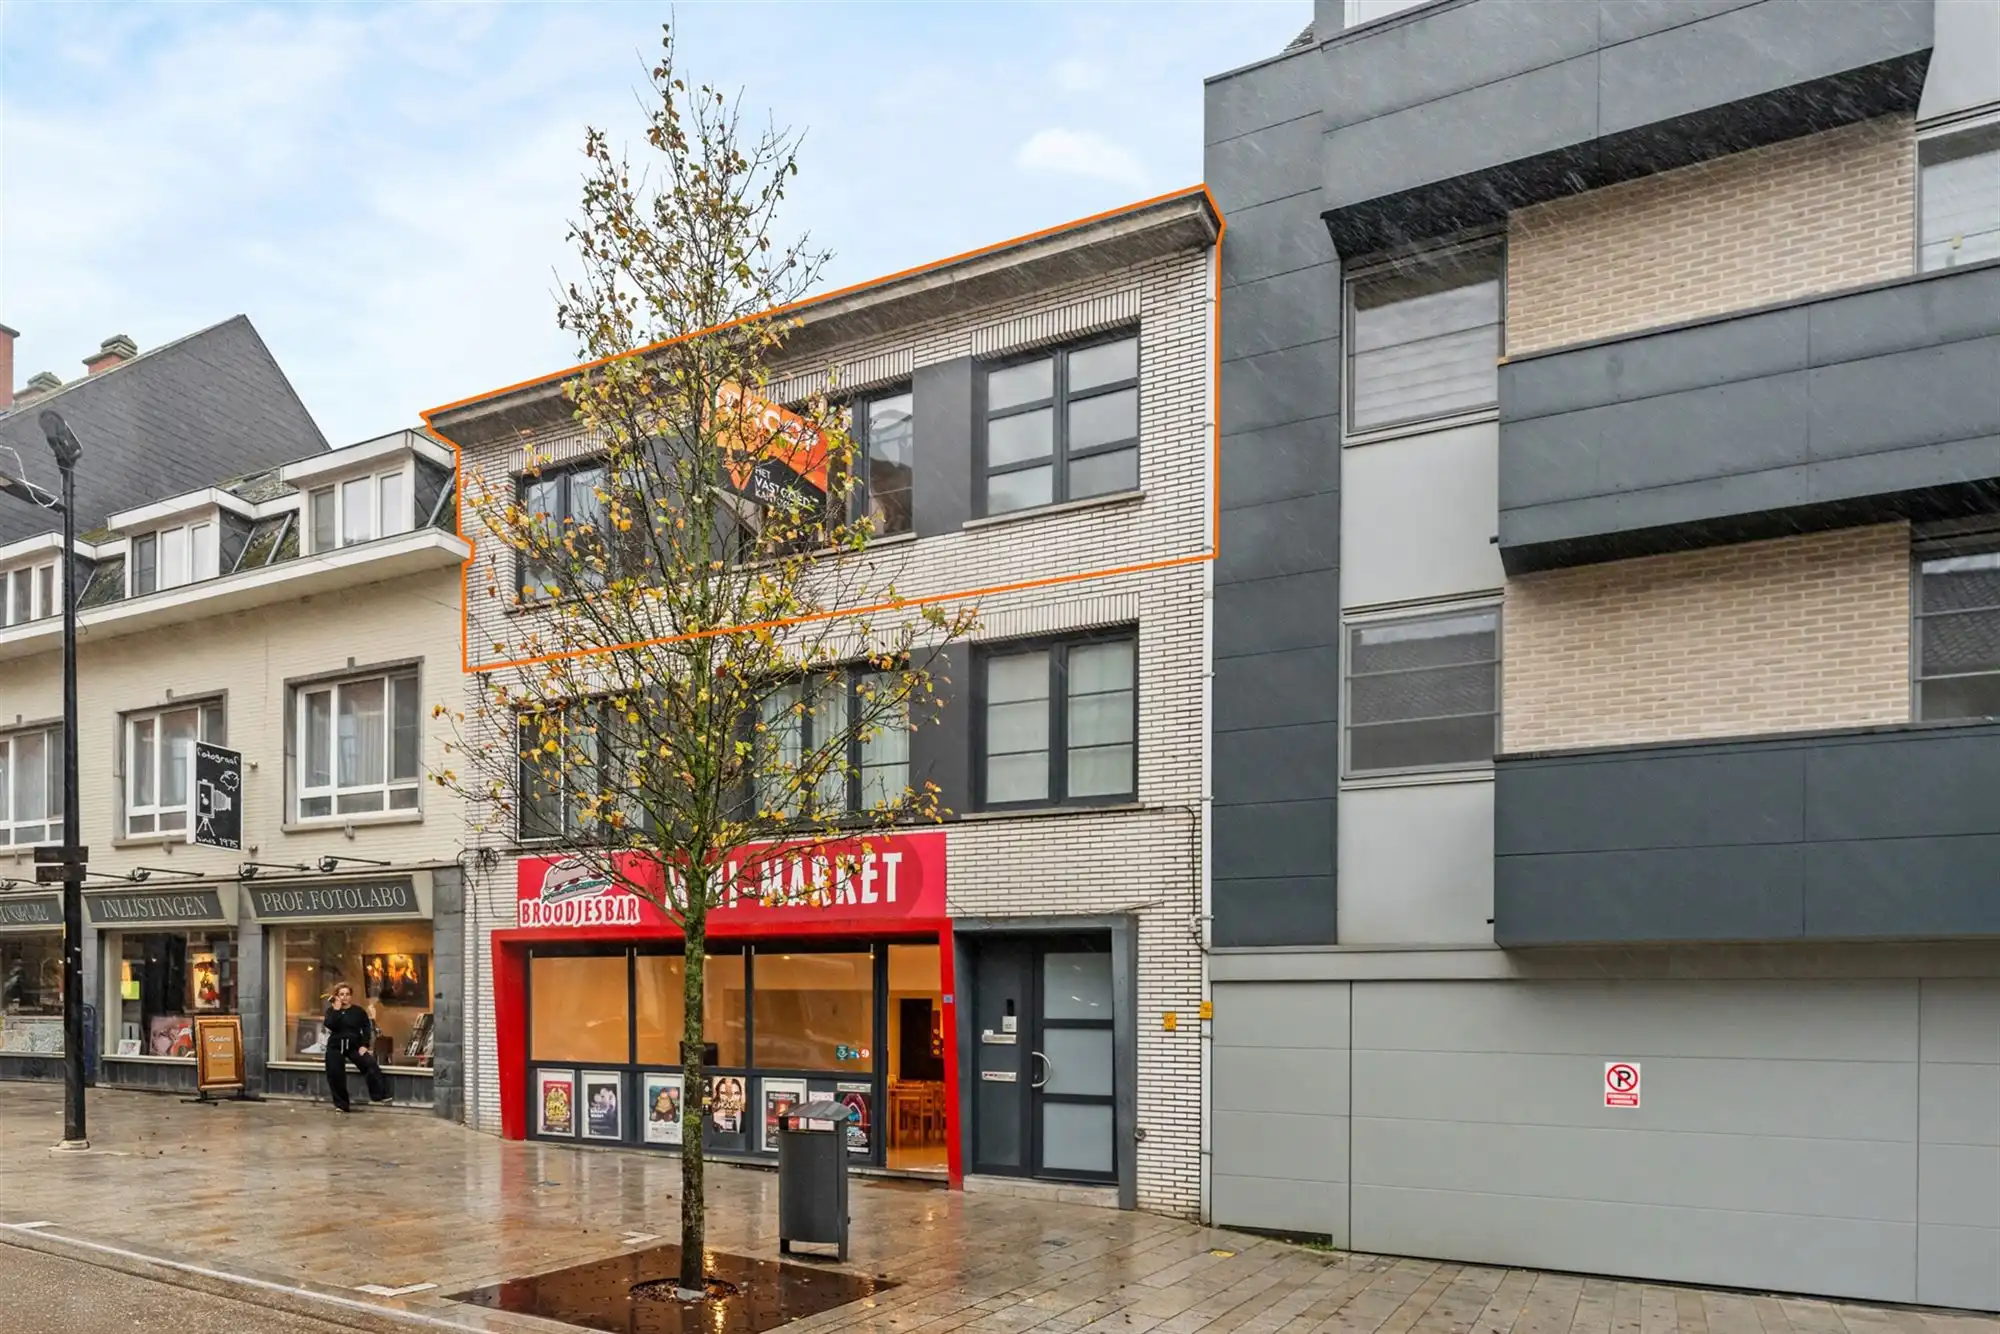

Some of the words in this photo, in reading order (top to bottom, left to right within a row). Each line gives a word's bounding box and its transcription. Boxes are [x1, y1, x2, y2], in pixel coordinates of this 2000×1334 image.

[219, 838, 238, 849] 1975
[101, 896, 208, 918] INLIJSTINGEN
[520, 896, 639, 926] BROODJESBAR
